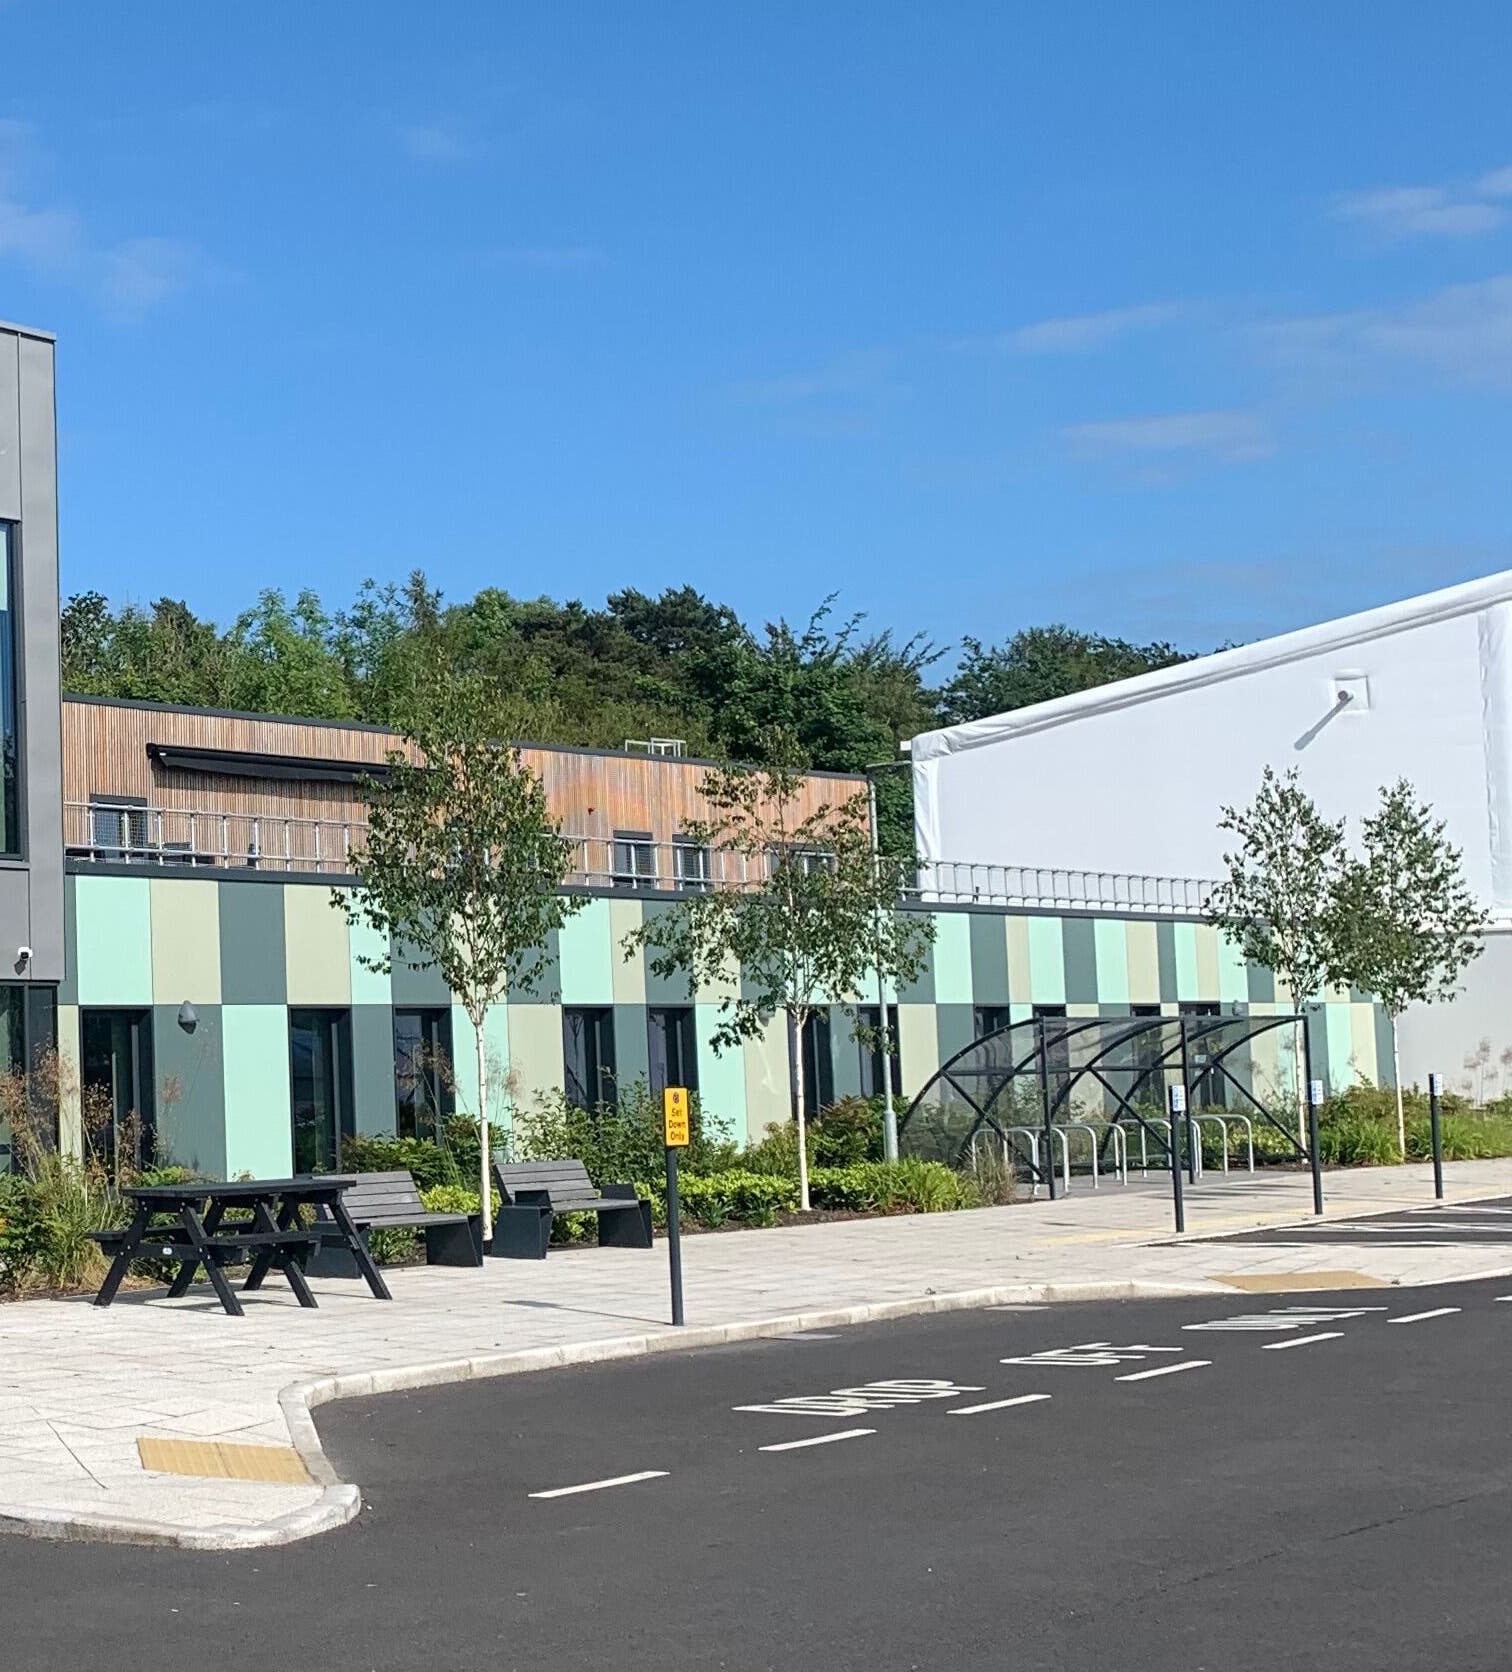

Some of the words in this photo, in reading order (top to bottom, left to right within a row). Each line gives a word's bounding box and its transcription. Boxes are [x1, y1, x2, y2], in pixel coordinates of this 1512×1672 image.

[671, 1107, 683, 1117] Set
[669, 1119, 686, 1129] Down
[670, 1131, 685, 1141] Only
[731, 1379, 987, 1417] DROP
[999, 1341, 1185, 1366] OFF
